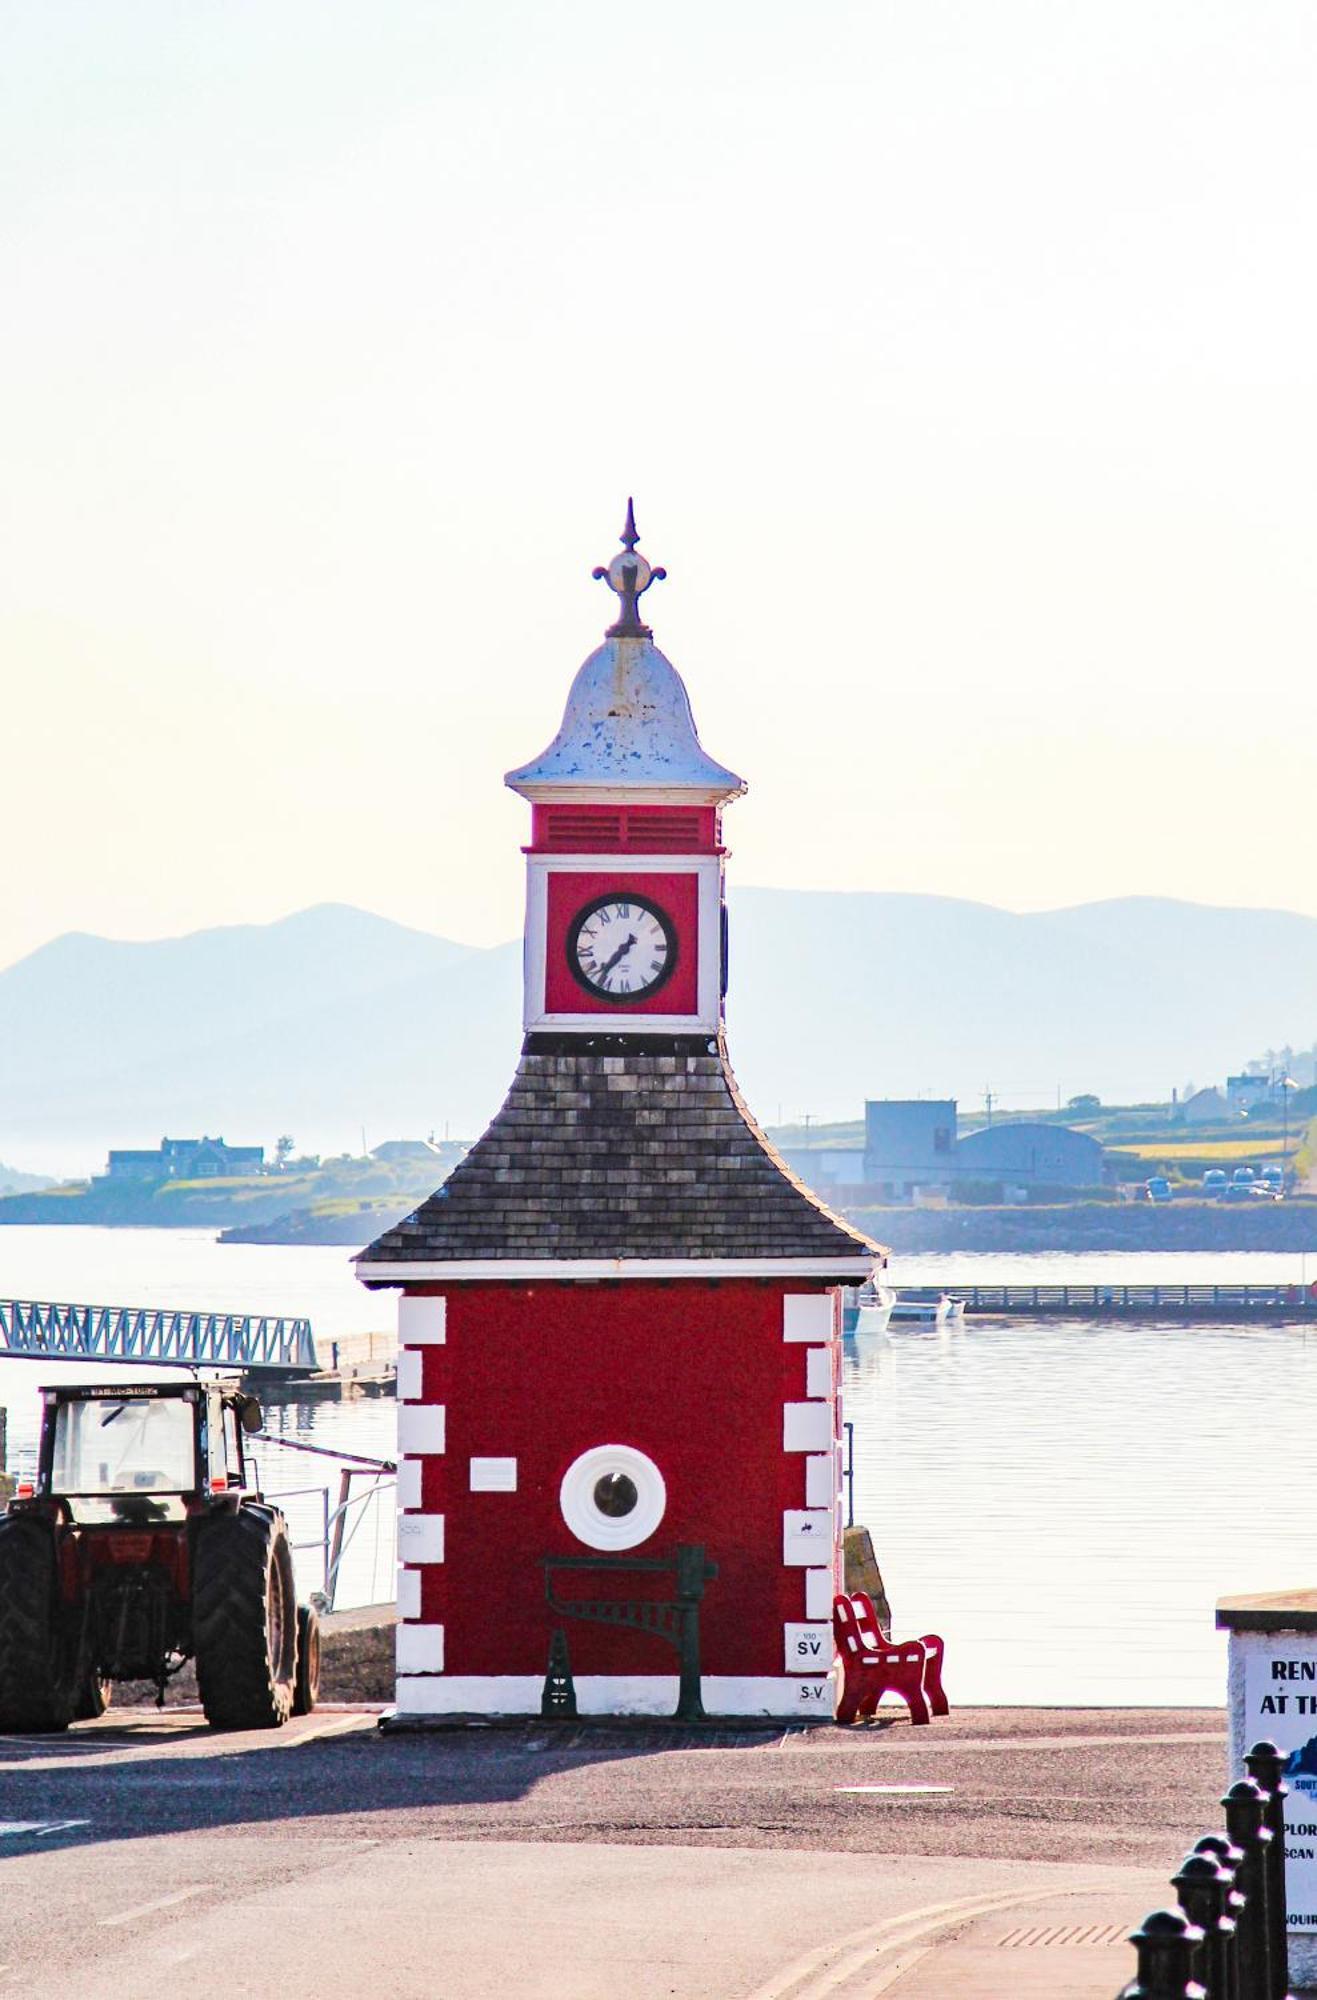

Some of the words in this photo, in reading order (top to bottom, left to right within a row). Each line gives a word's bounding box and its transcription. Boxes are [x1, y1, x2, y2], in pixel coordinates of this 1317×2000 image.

[1272, 1660, 1317, 1680] REN
[1260, 1695, 1289, 1714] AT
[1284, 1848, 1314, 1859] SCAN
